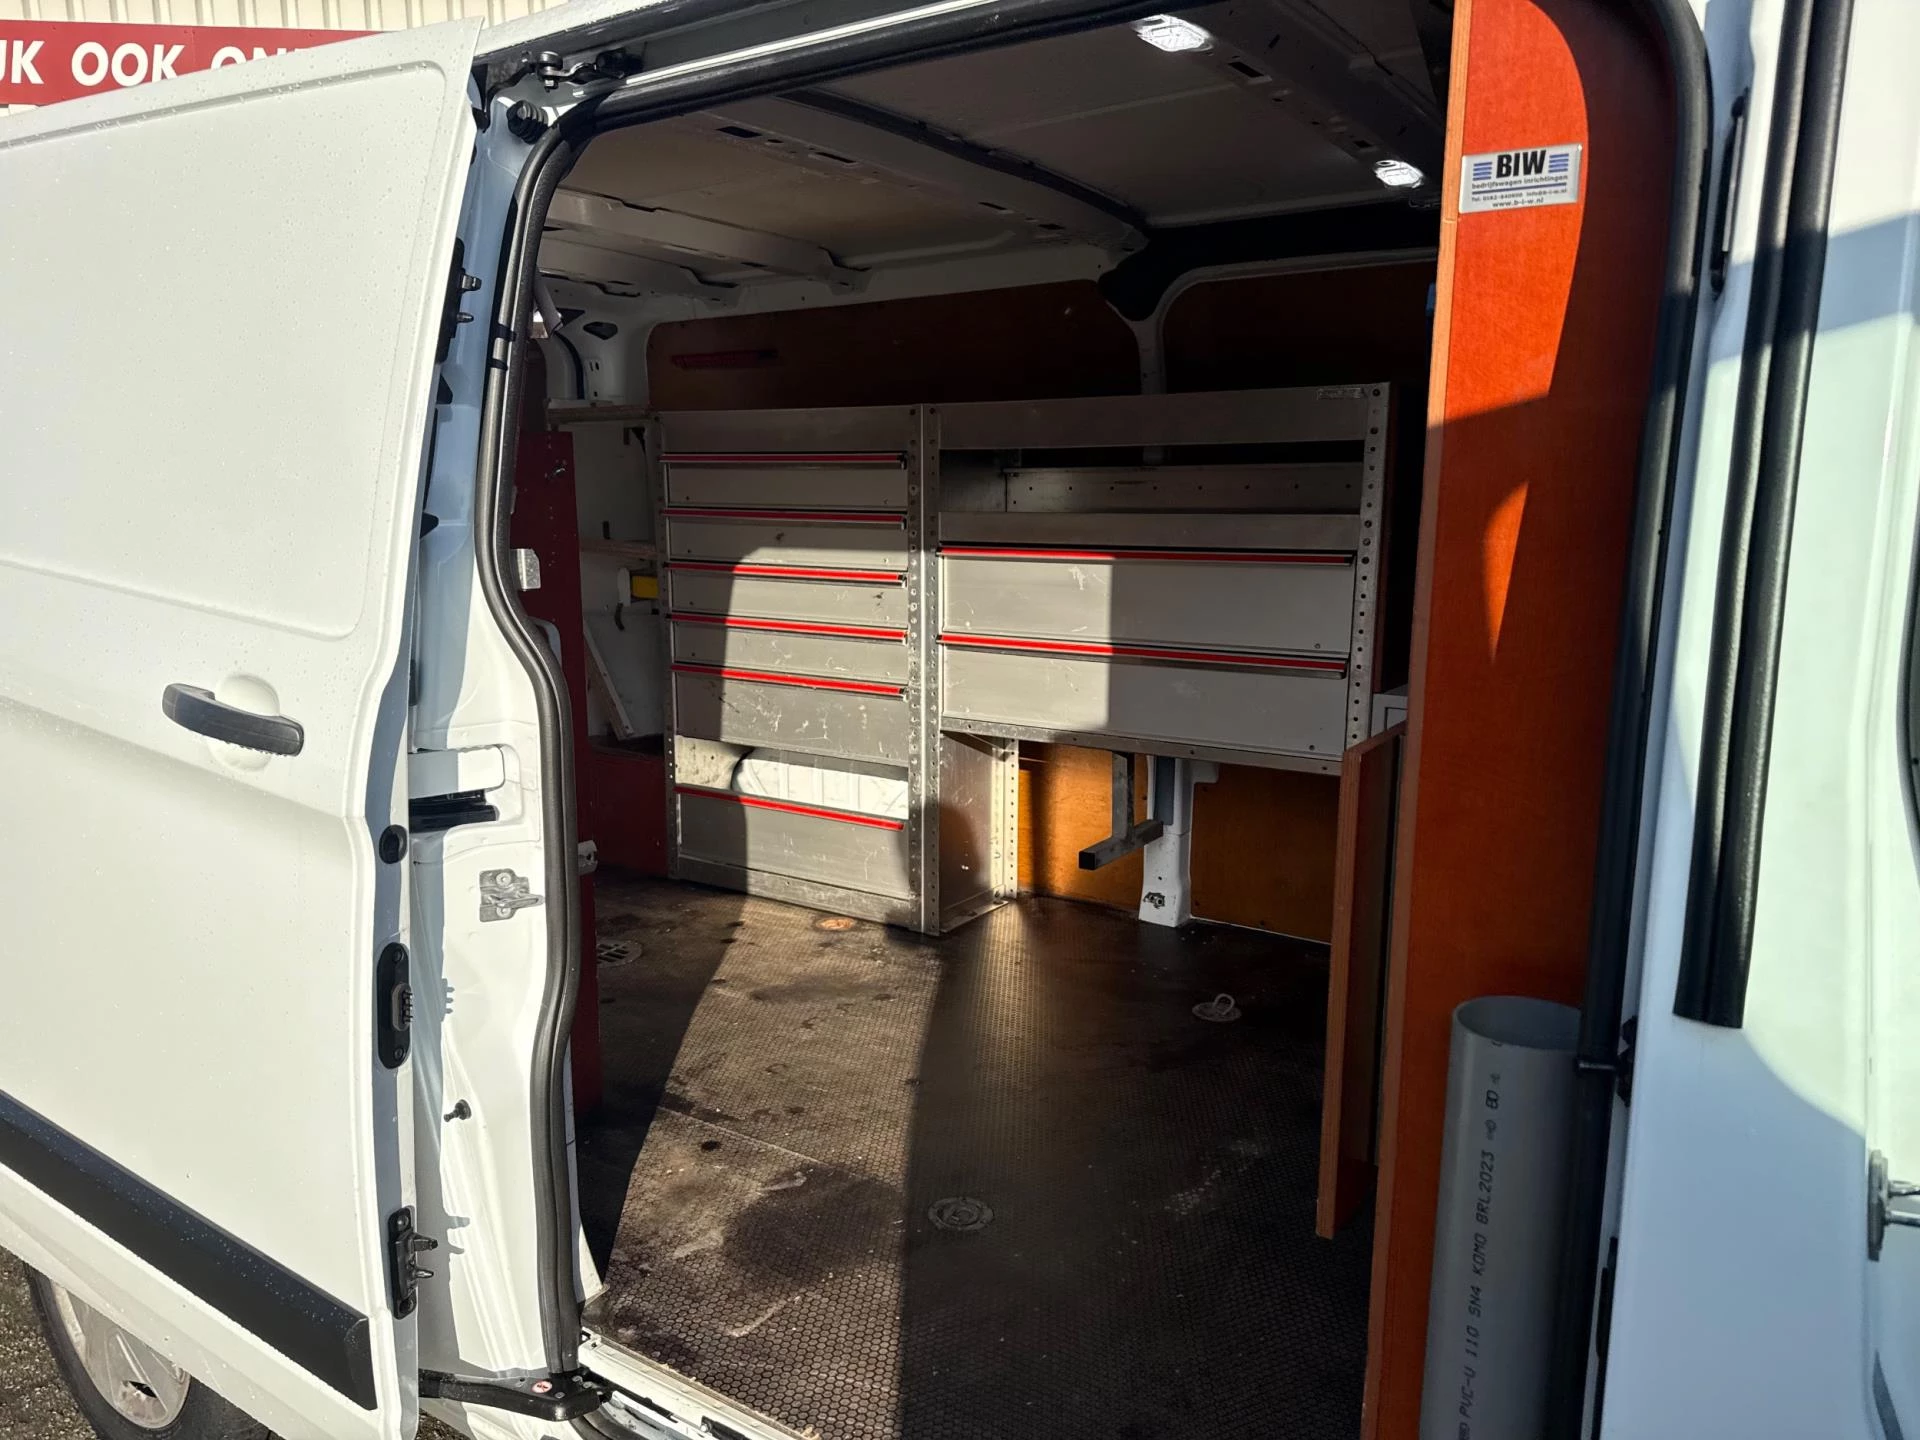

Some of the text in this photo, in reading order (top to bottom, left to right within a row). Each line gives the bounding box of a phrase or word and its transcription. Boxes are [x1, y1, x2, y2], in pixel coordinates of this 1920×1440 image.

[71, 41, 185, 87] OOK
[1496, 150, 1547, 178] BIW
[1472, 1232, 1488, 1277] KOMO
[1468, 1285, 1483, 1318] SN4
[1465, 1324, 1481, 1358] 110
